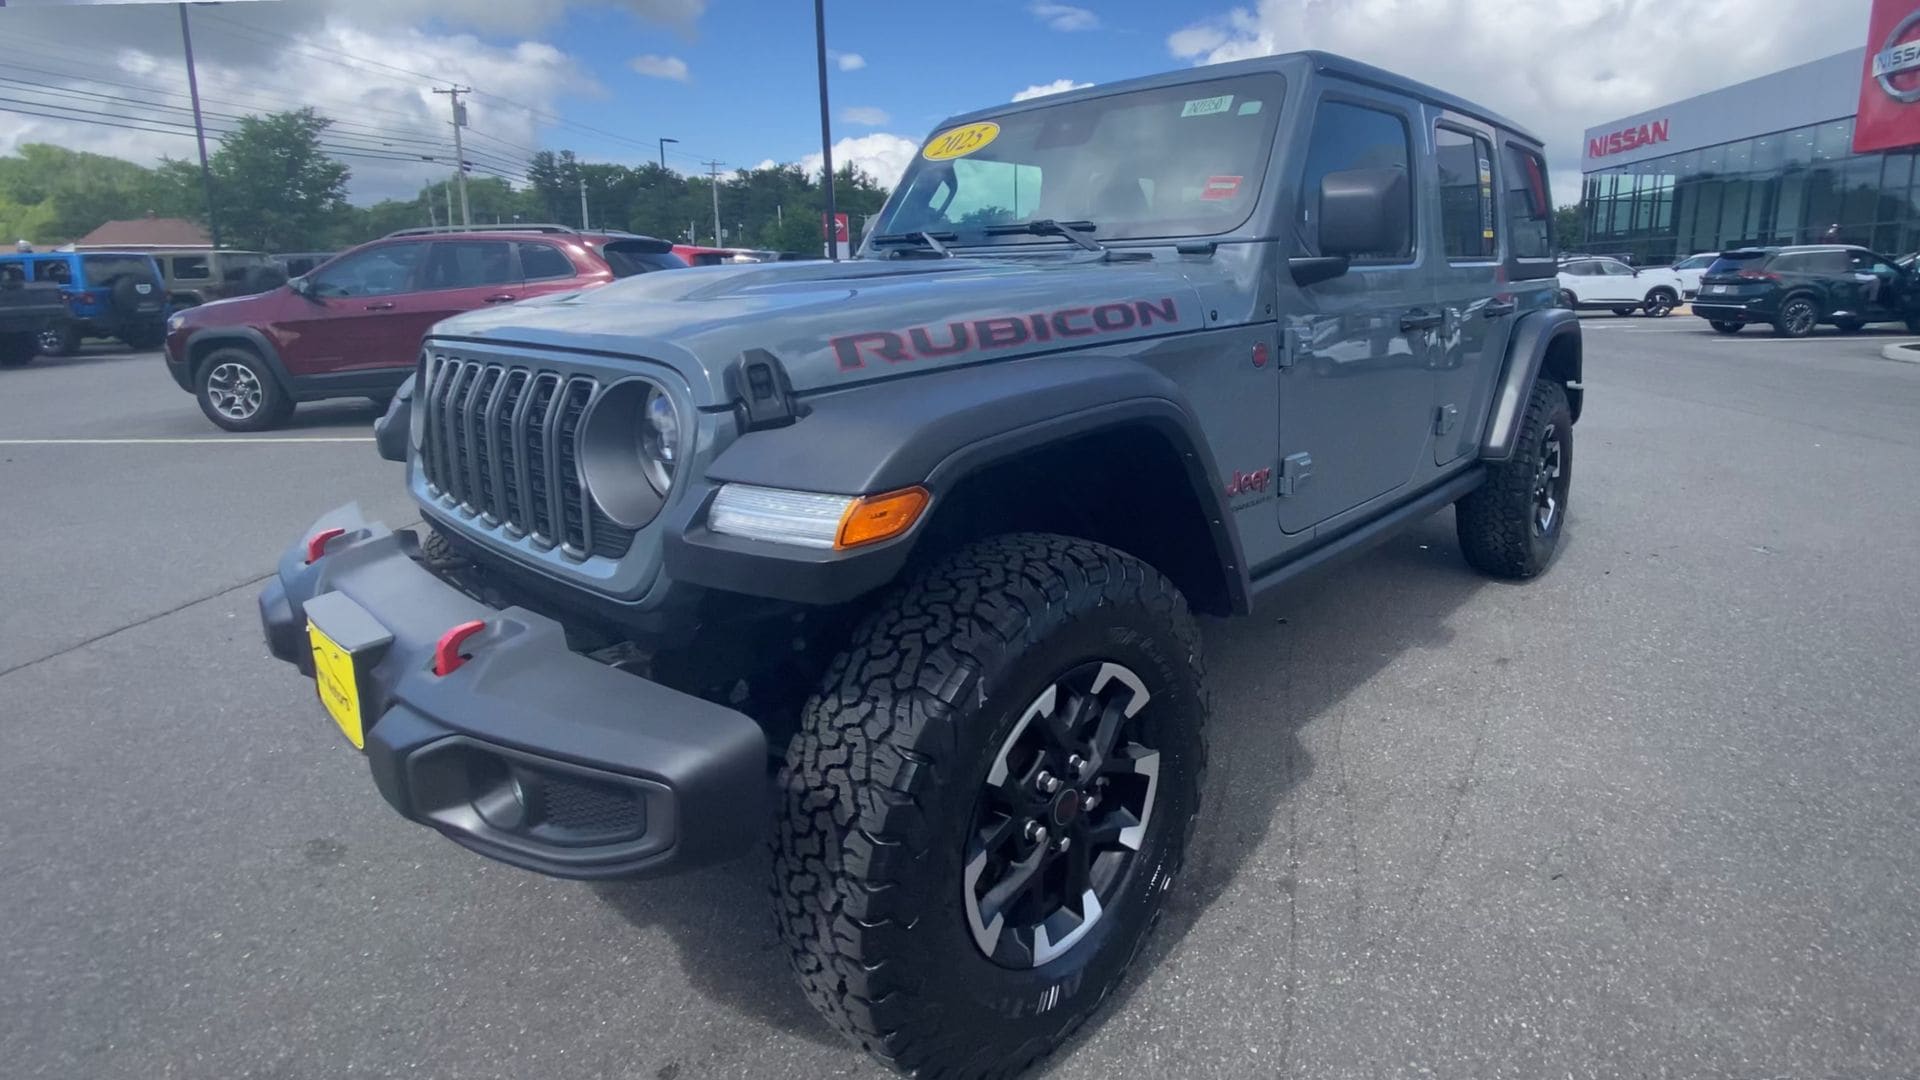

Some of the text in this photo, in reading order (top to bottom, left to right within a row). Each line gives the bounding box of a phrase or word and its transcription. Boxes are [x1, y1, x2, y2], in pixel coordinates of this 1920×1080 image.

[1876, 46, 1920, 71] NISS
[931, 126, 990, 157] 2025
[1588, 118, 1669, 158] NISSAN
[829, 297, 1180, 373] RUBICON
[1226, 467, 1271, 497] Jeep
